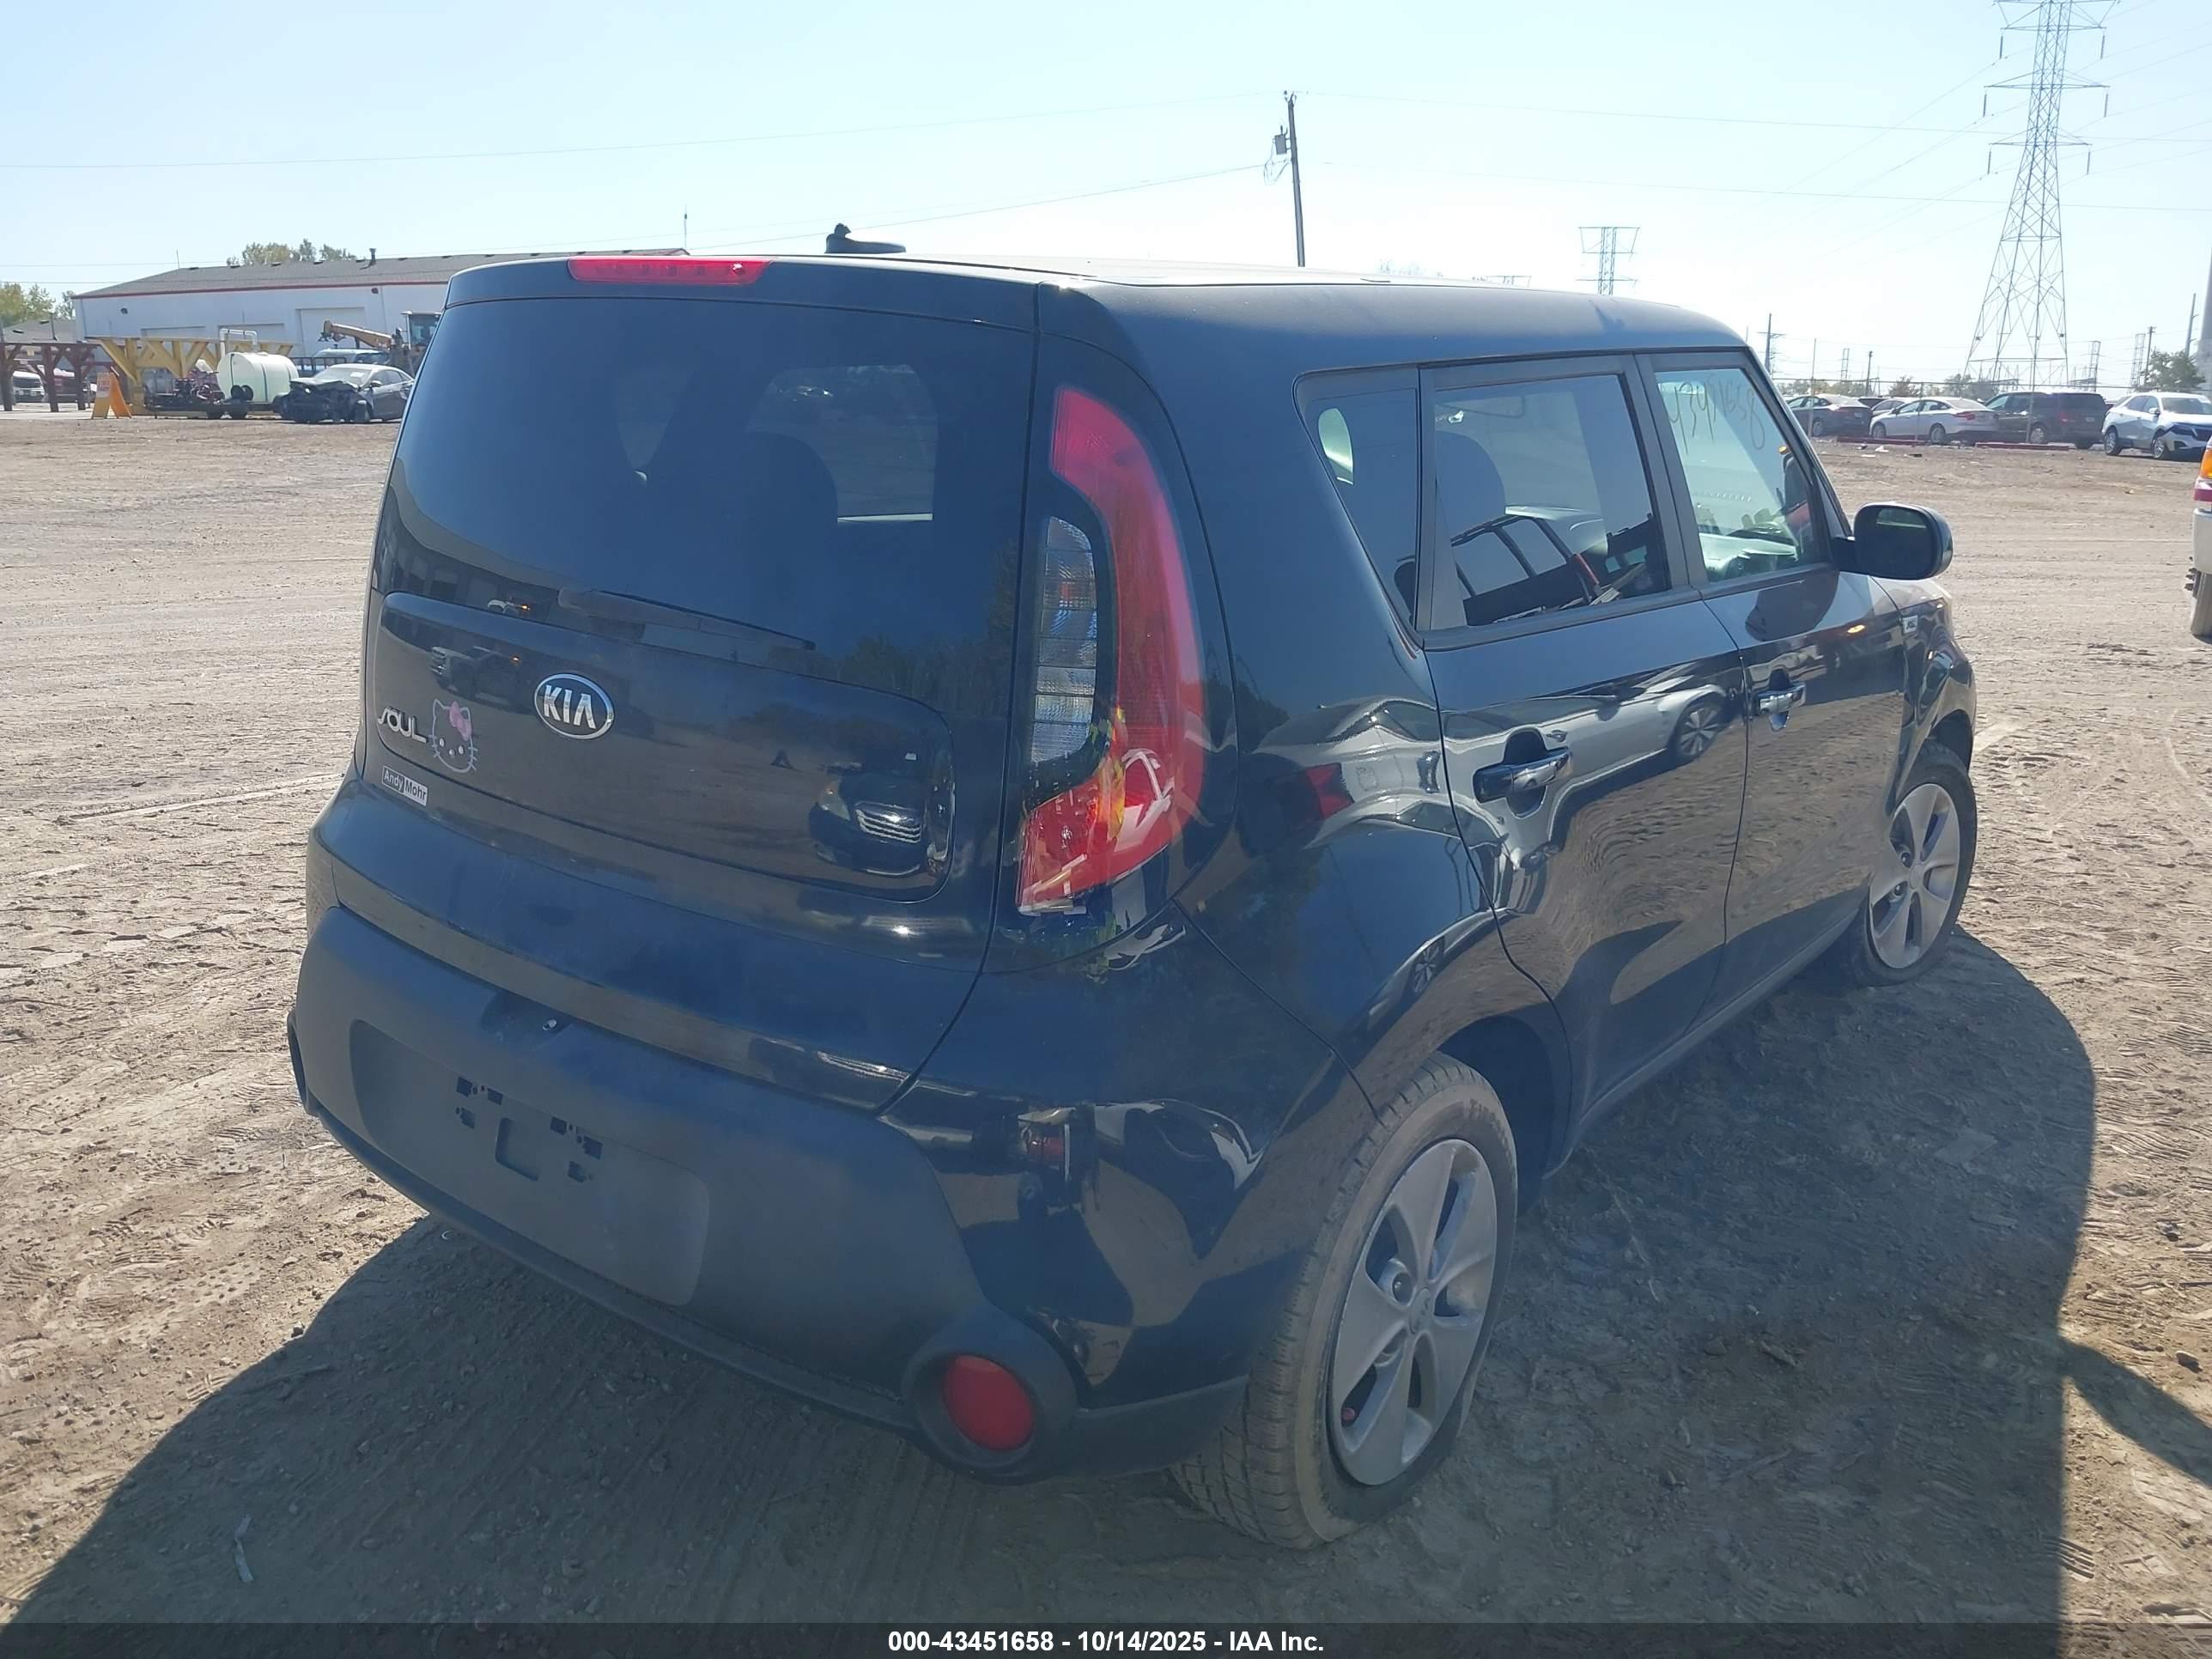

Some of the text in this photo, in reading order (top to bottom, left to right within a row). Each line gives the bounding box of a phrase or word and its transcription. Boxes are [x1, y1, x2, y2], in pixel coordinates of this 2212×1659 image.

[544, 684, 597, 729] KIA
[377, 707, 428, 743] SOUL
[384, 769, 427, 799] Andy Mohr
